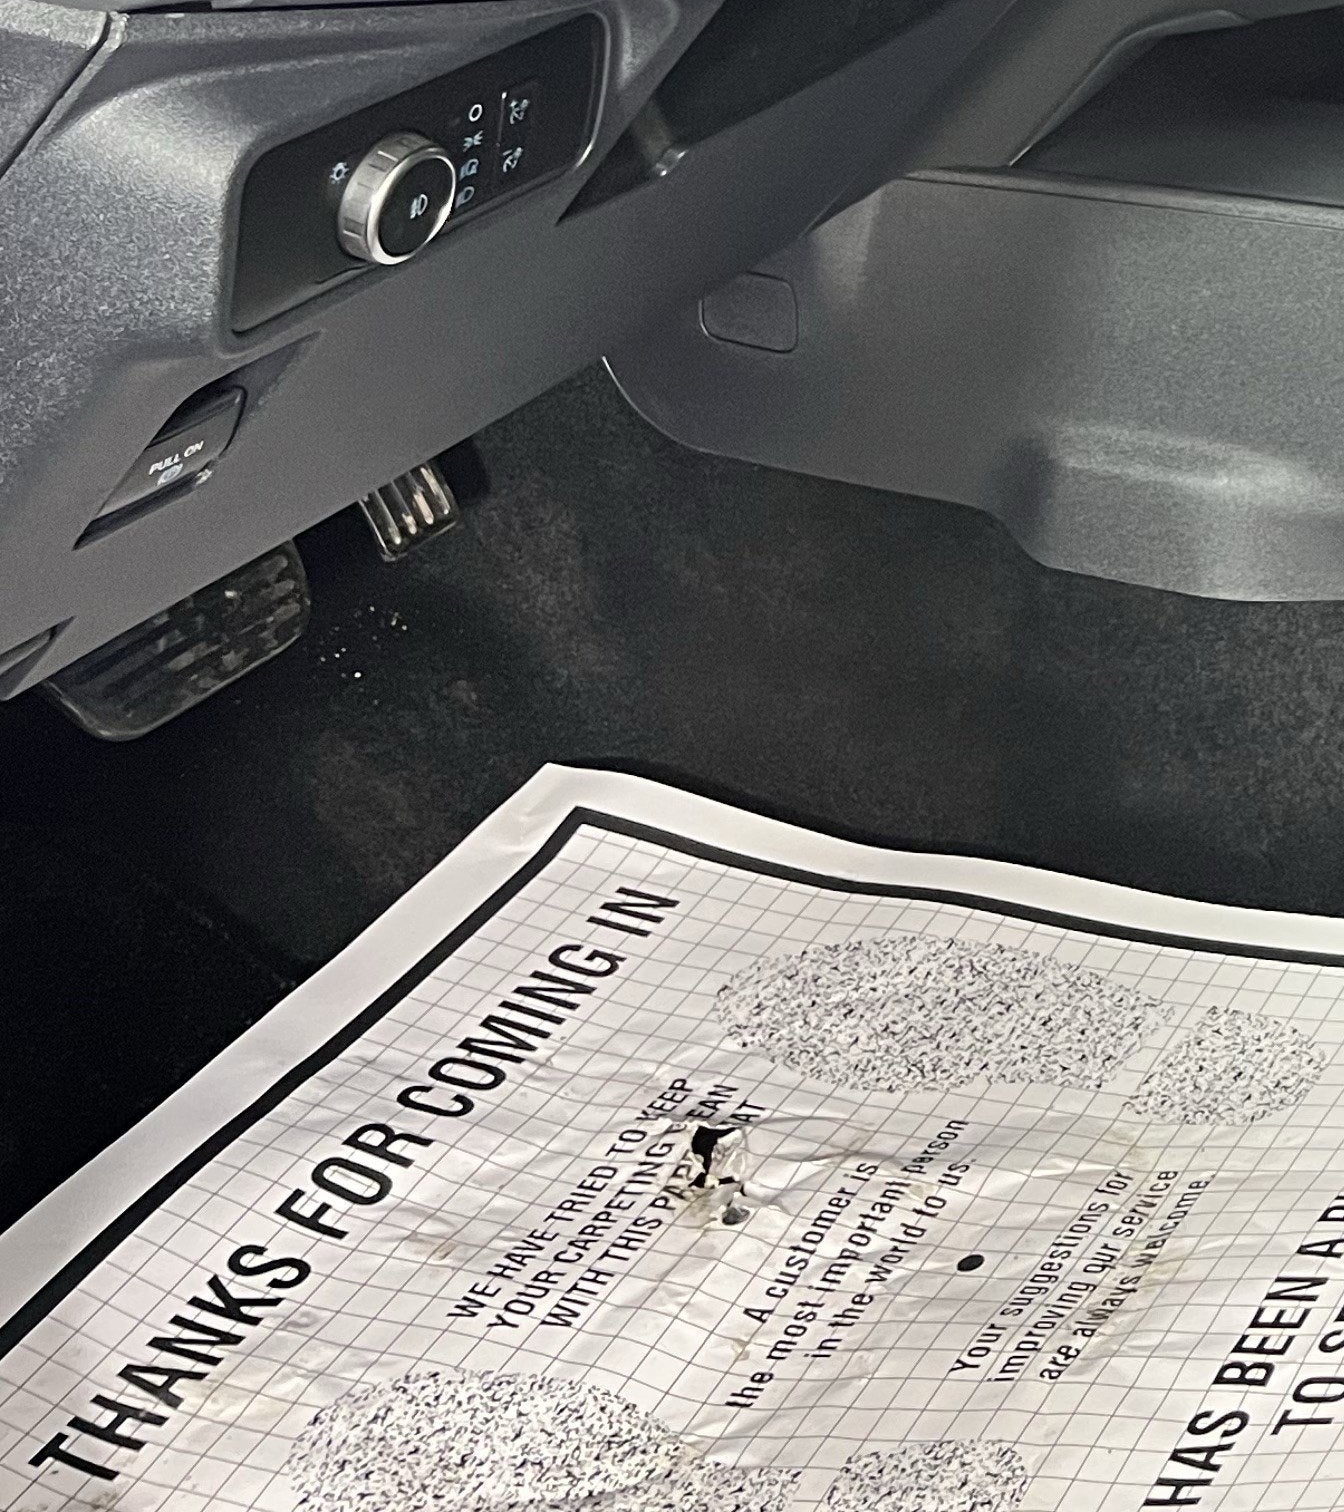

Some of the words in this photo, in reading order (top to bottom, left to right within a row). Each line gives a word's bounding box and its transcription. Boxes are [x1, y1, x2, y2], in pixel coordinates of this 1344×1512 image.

[148, 453, 180, 475] PULL
[183, 440, 204, 458] ON
[28, 1244, 312, 1481] THANKS
[274, 1121, 434, 1240] FOR
[396, 944, 628, 1118] COMING
[587, 886, 681, 938] IN
[446, 1283, 501, 1319] WE
[488, 1227, 559, 1279] HAVE
[543, 1165, 618, 1225] TRIED
[605, 1129, 648, 1158] TO
[635, 1078, 693, 1121] KEEP
[487, 1270, 566, 1329] YOUR
[553, 1142, 676, 1264] CARPETING
[661, 1084, 740, 1136] CEAN
[539, 1269, 616, 1329] WITH
[602, 1216, 663, 1263] THIS
[718, 1099, 767, 1124] AT
[725, 1371, 775, 1410] the
[766, 1300, 825, 1361] most
[807, 1179, 912, 1294] important
[901, 1119, 970, 1175] person
[743, 1305, 774, 1325] A
[765, 1186, 857, 1299] customer
[843, 1162, 879, 1184] is
[804, 1336, 843, 1359] in
[828, 1292, 875, 1329] the
[865, 1222, 928, 1285] world
[912, 1195, 948, 1218] to
[938, 1158, 977, 1187] us.
[950, 1322, 1009, 1374] Your
[1000, 1201, 1110, 1317] suggestions
[1094, 1170, 1135, 1196] for
[986, 1280, 1098, 1383] improving
[1083, 1242, 1122, 1274] our
[1112, 1170, 1180, 1238] service
[1039, 1344, 1081, 1381] are
[1072, 1275, 1144, 1338] always
[1131, 1173, 1218, 1270] welcome.
[1142, 1409, 1251, 1507] HAS
[1213, 1276, 1331, 1387] BEEN
